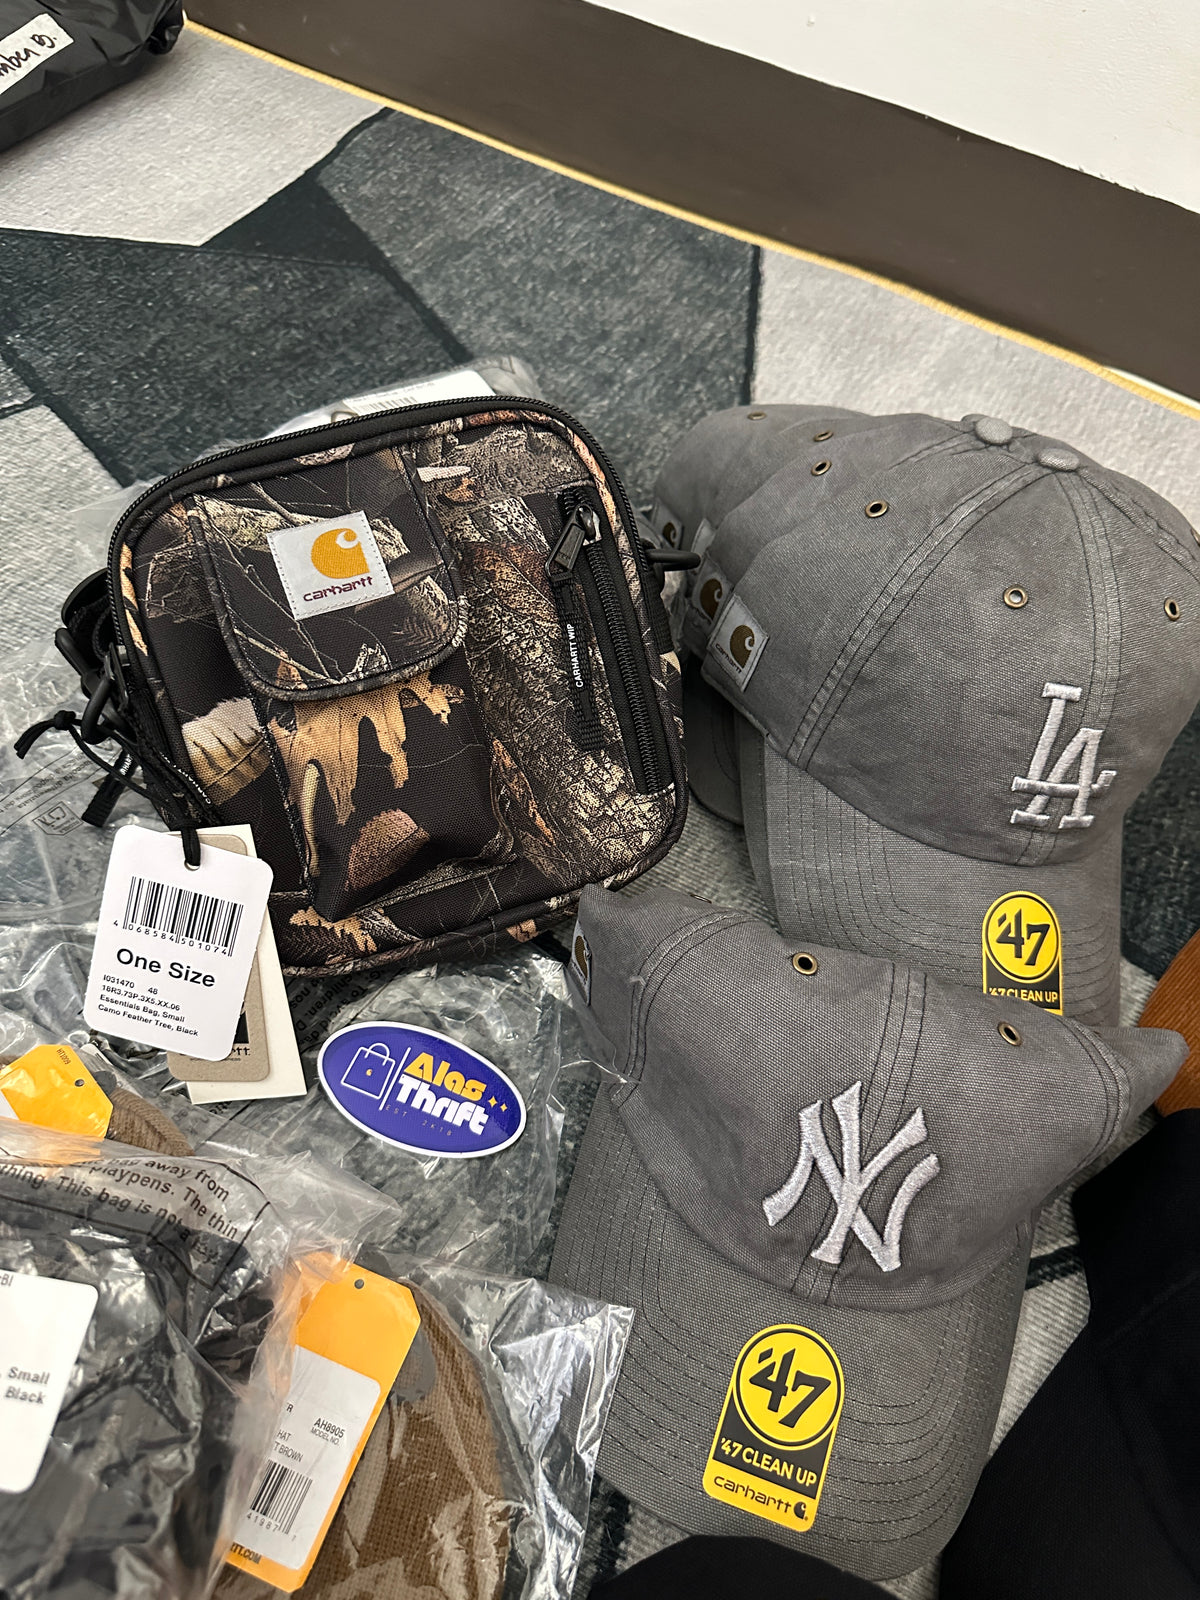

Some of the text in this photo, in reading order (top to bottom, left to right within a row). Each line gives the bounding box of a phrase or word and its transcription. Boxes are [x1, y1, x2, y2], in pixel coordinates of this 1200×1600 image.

[303, 576, 373, 602] carhartt
[566, 623, 584, 688] CARHARTT WIP
[1010, 682, 1118, 830] LA
[116, 948, 216, 988] One Size
[147, 986, 158, 995] 48
[1044, 991, 1059, 1003] UP
[97, 1004, 199, 1037] Camo Feather Tree, Black
[99, 994, 186, 1024] Essentials Bag, Small
[403, 1051, 488, 1102] Alas
[395, 1073, 490, 1136] Thrift
[145, 1160, 193, 1179] away
[195, 1170, 230, 1203] from
[761, 1080, 941, 1273] NY
[56, 1175, 93, 1198] This
[99, 1186, 132, 1213] bag
[136, 1199, 150, 1214] is
[183, 1186, 208, 1218] The
[208, 1211, 240, 1241] thin
[8, 1366, 50, 1385] Small
[5, 1386, 47, 1405] Black
[277, 1429, 292, 1442] HAT
[310, 1427, 329, 1443] MODEL
[313, 1417, 346, 1438] AH8905
[279, 1444, 304, 1463] BROWN
[742, 1446, 795, 1480] CLEAN
[795, 1466, 818, 1487] UP
[713, 1475, 792, 1513] carhartt
